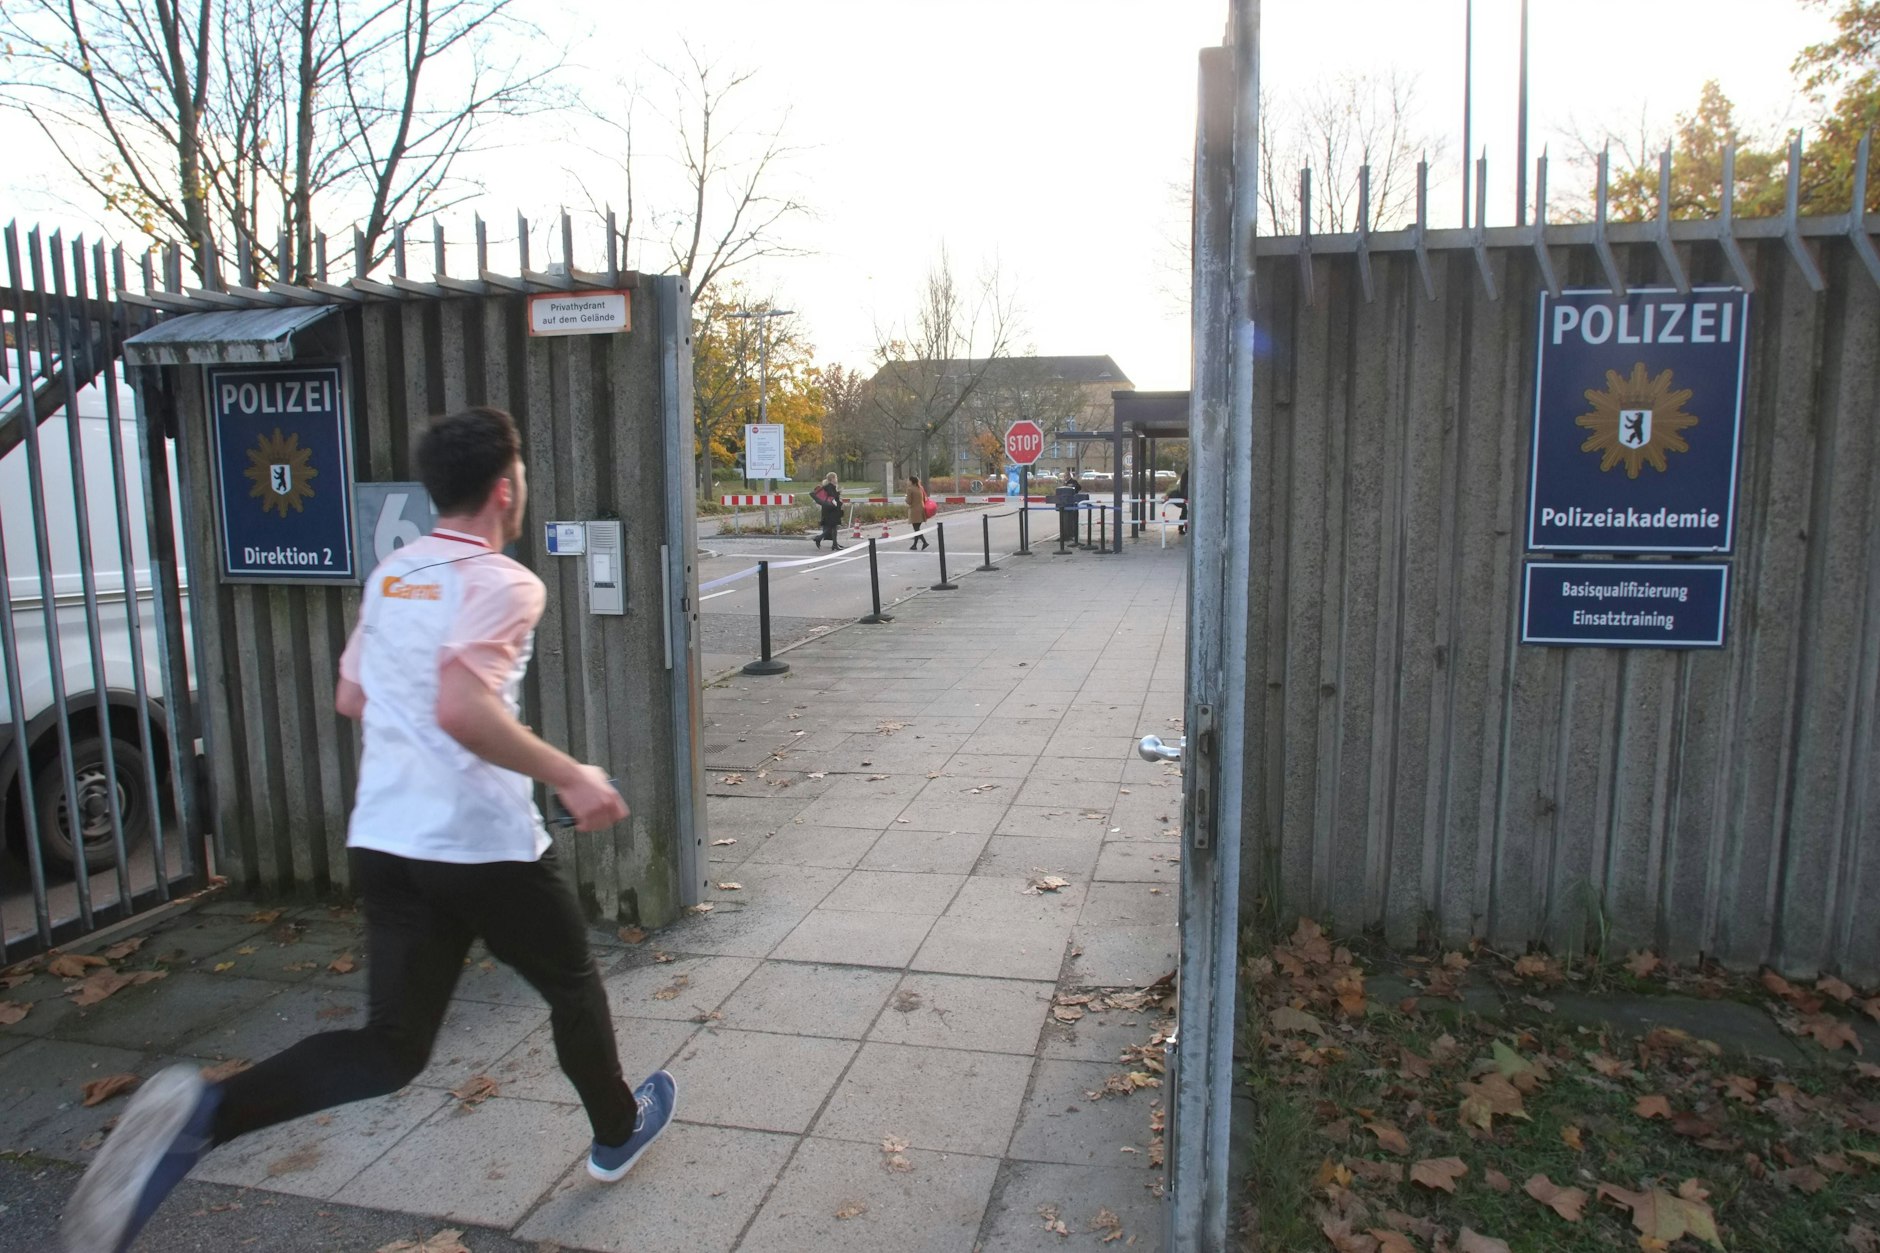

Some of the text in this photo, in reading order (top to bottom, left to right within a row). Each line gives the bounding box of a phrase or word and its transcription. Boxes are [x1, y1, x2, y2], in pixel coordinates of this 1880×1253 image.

[550, 301, 605, 312] Privathydrant
[542, 313, 615, 325] auf dem Gelände
[1552, 302, 1733, 345] POLIZEI
[222, 380, 331, 415] POLIZEI
[1009, 434, 1039, 452] STOP
[1541, 507, 1720, 528] Polizeiakademie
[374, 493, 440, 564] 6
[244, 546, 333, 566] Direktion 2
[1562, 581, 1688, 602] Basisqualifizierung
[1572, 609, 1674, 631] Einsatztraining
